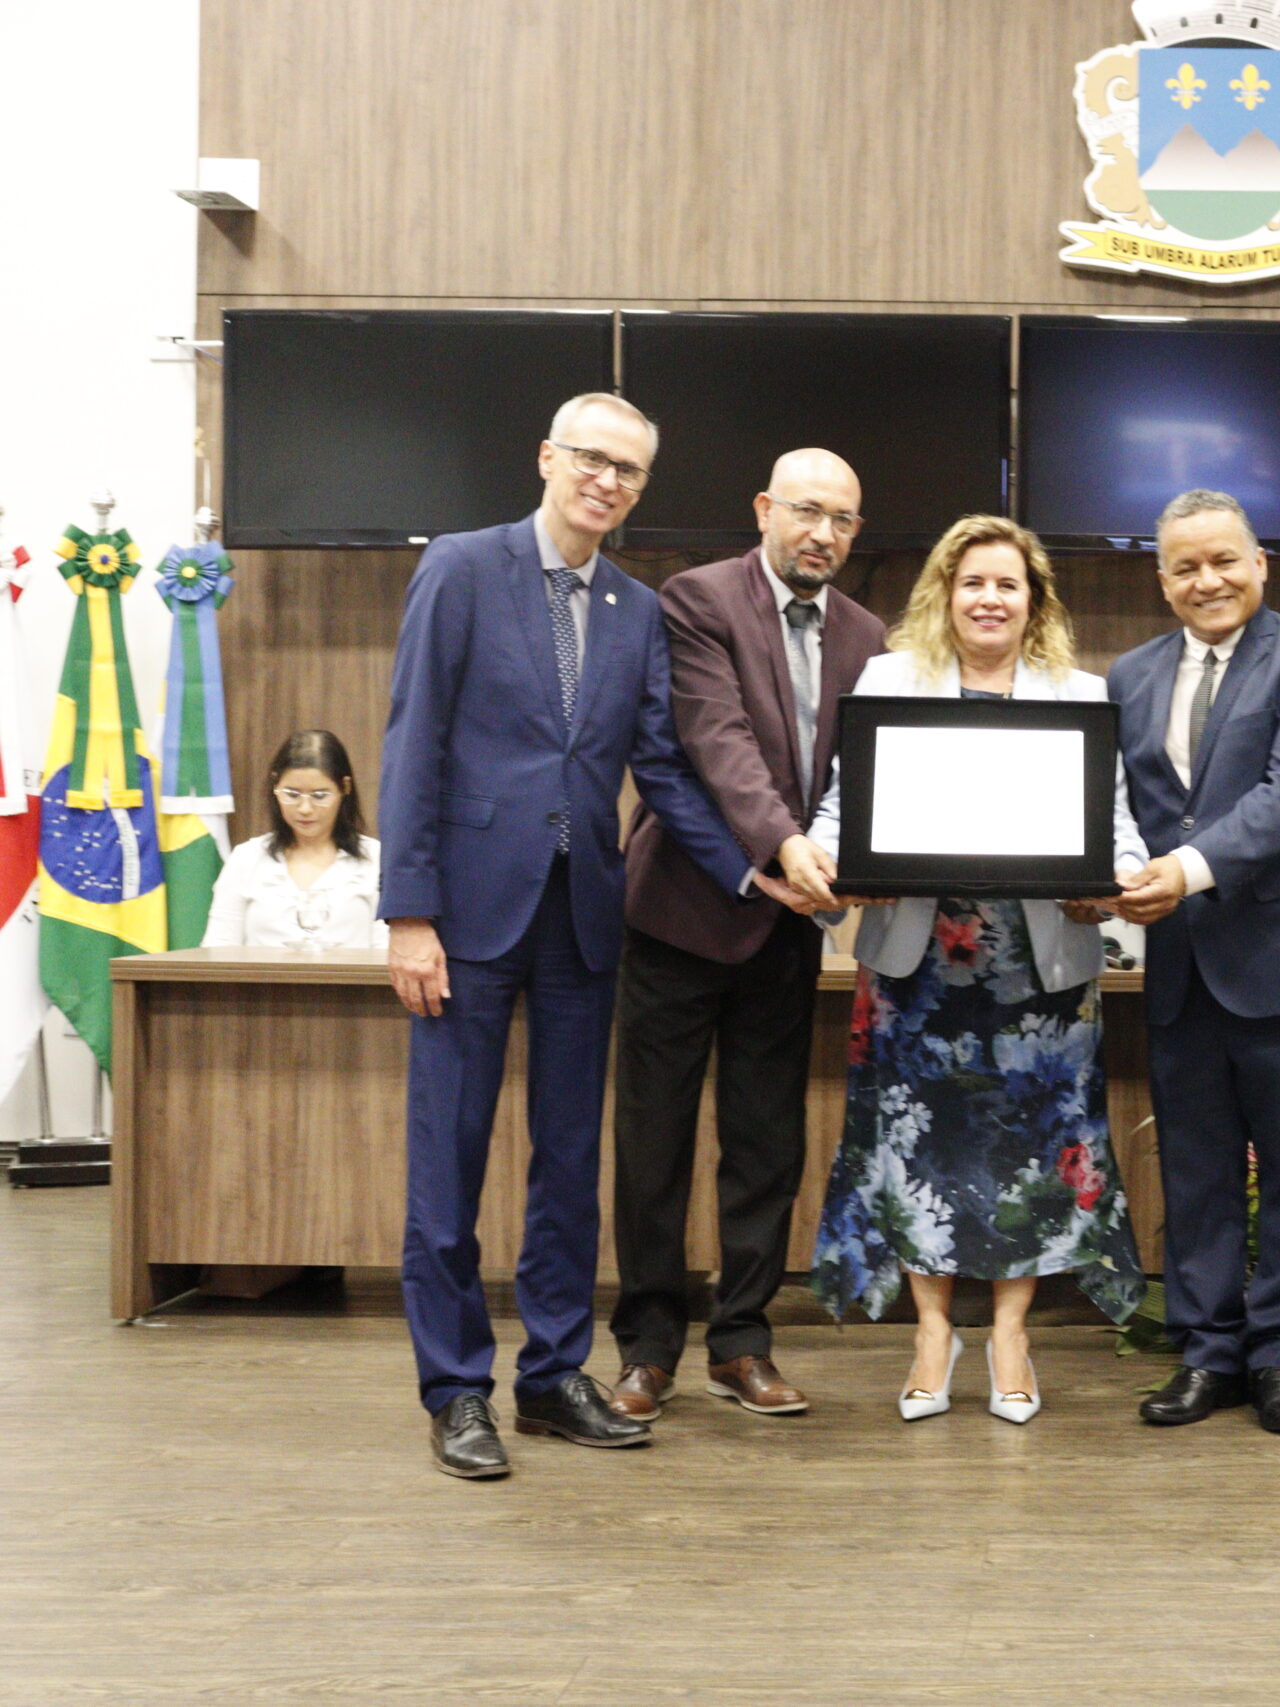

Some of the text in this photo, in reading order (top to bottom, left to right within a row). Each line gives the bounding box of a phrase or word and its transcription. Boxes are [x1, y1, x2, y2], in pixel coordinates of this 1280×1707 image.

[1112, 236, 1139, 256] SUB
[1145, 245, 1194, 265] UMBRA
[1200, 253, 1256, 269] ALARUM
